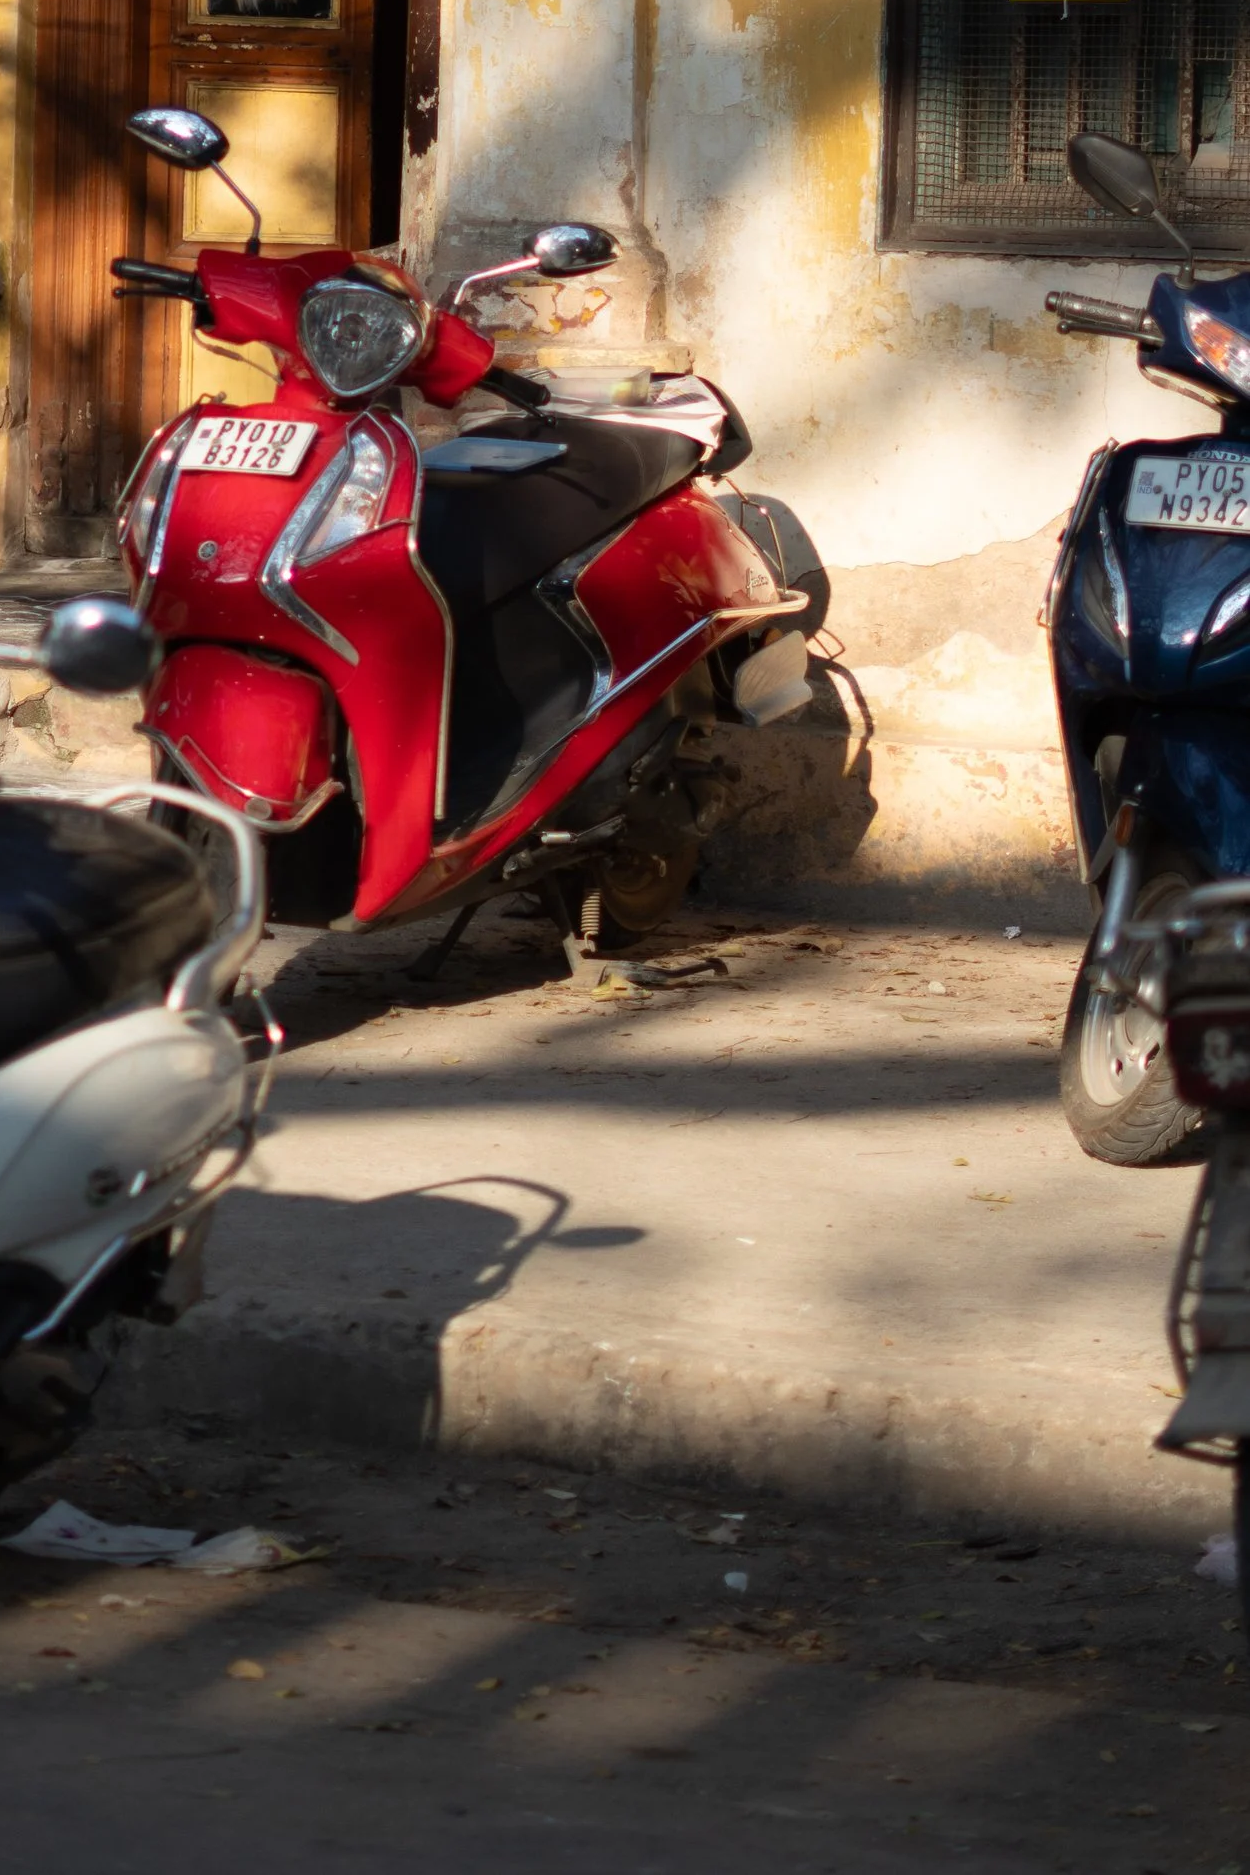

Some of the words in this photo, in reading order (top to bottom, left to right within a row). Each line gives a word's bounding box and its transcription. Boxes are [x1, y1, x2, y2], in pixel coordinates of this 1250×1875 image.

[202, 444, 286, 469] B3126
[1176, 463, 1245, 494] PY05
[1159, 494, 1248, 526] N9342
